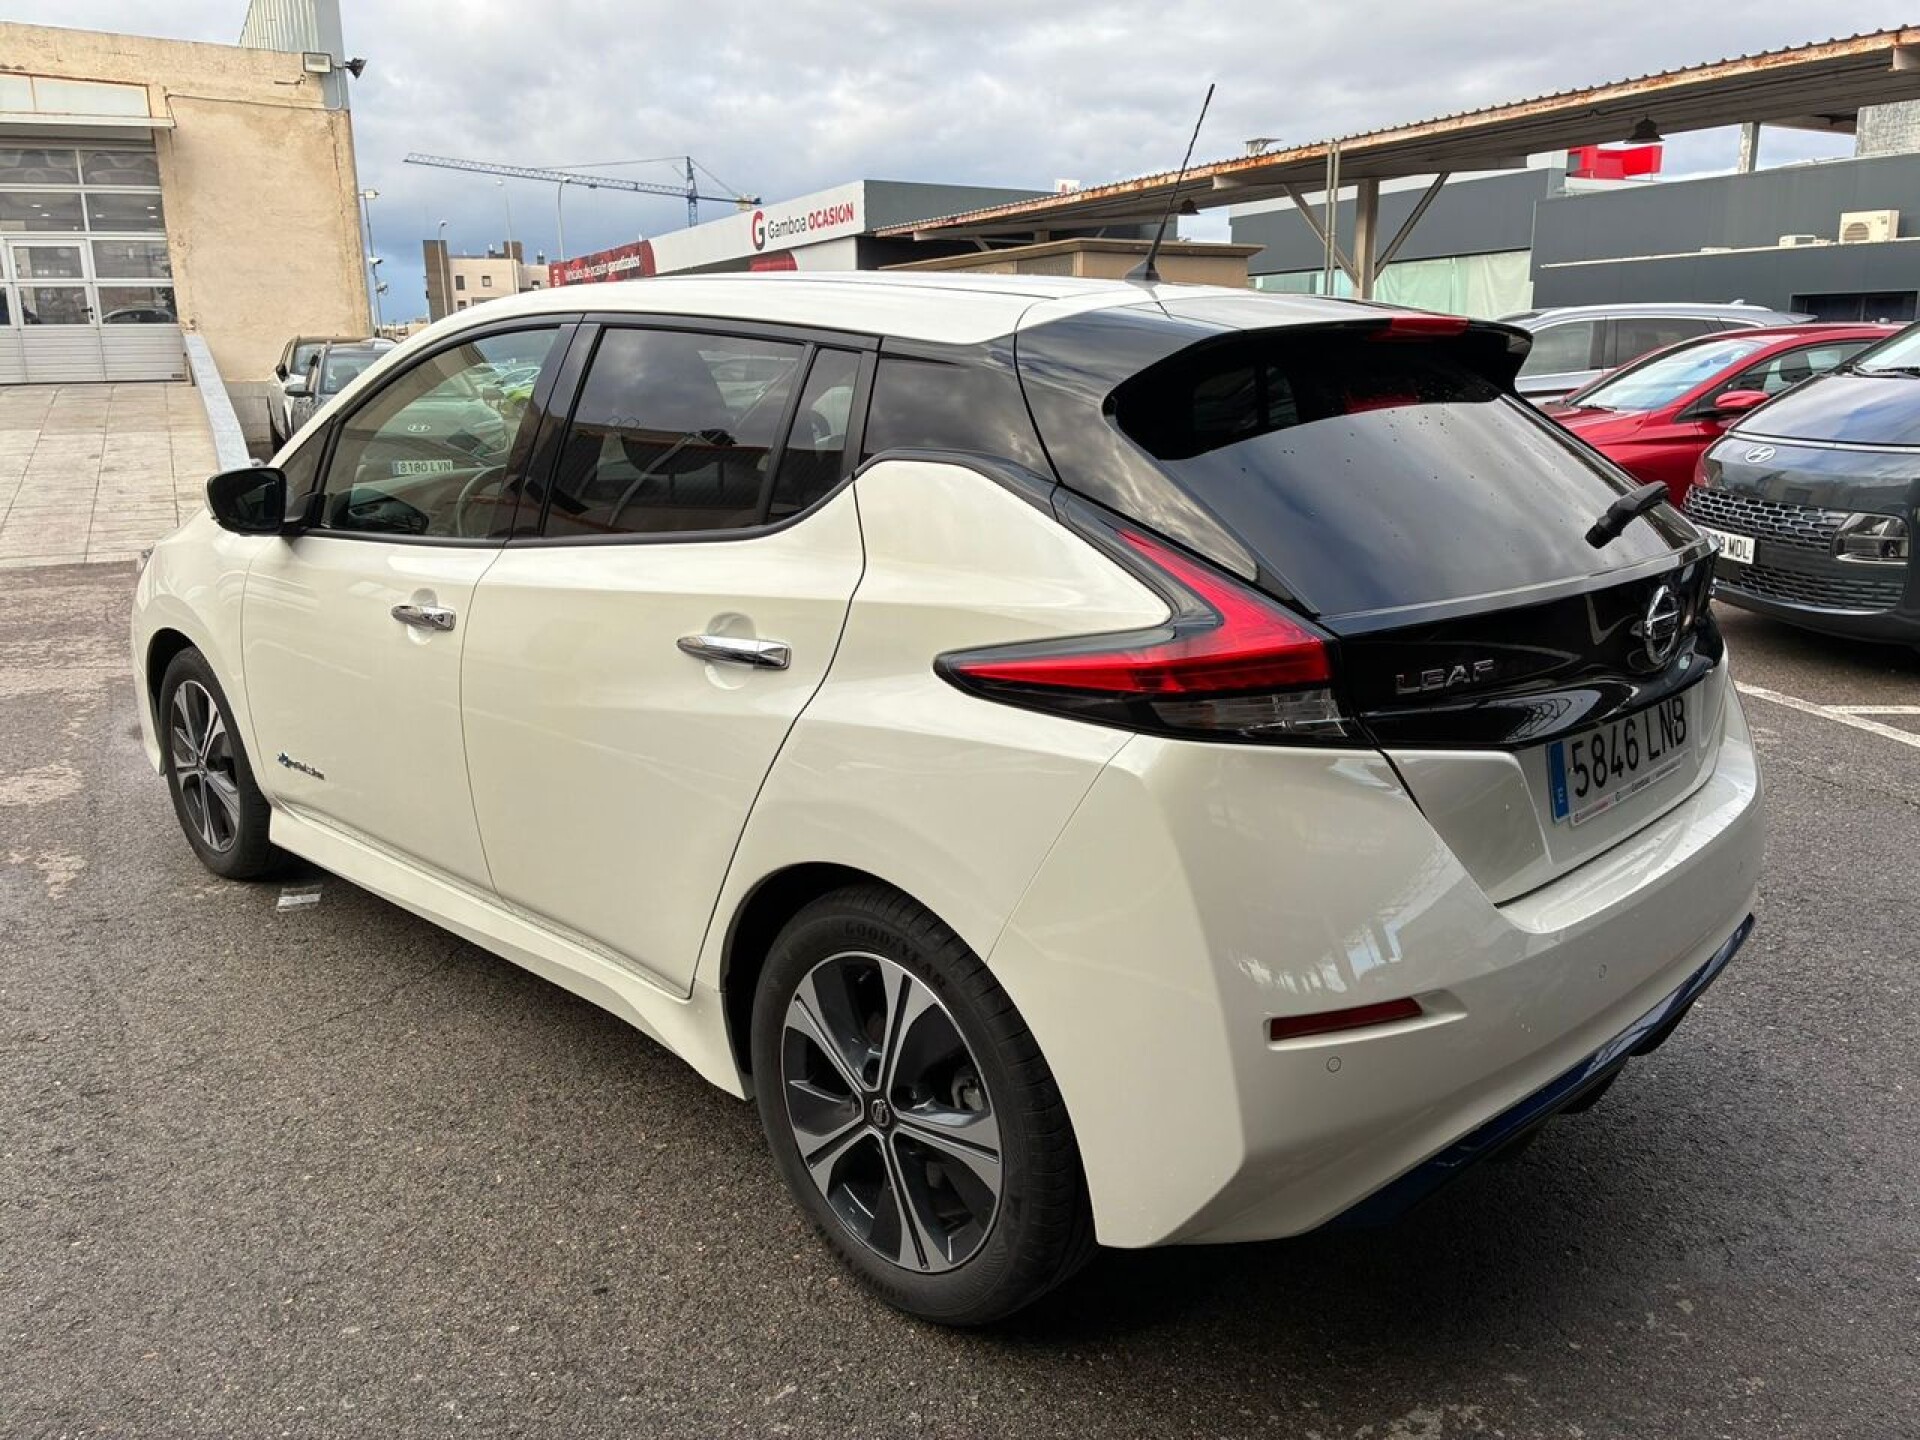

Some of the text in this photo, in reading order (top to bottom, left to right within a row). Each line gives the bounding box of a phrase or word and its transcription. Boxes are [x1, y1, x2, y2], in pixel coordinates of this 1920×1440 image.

[768, 215, 806, 239] Gamboa
[808, 201, 854, 230] OCASION
[1394, 659, 1495, 695] LEAF
[1571, 718, 1639, 798] 5846
[1644, 696, 1687, 760] LNB
